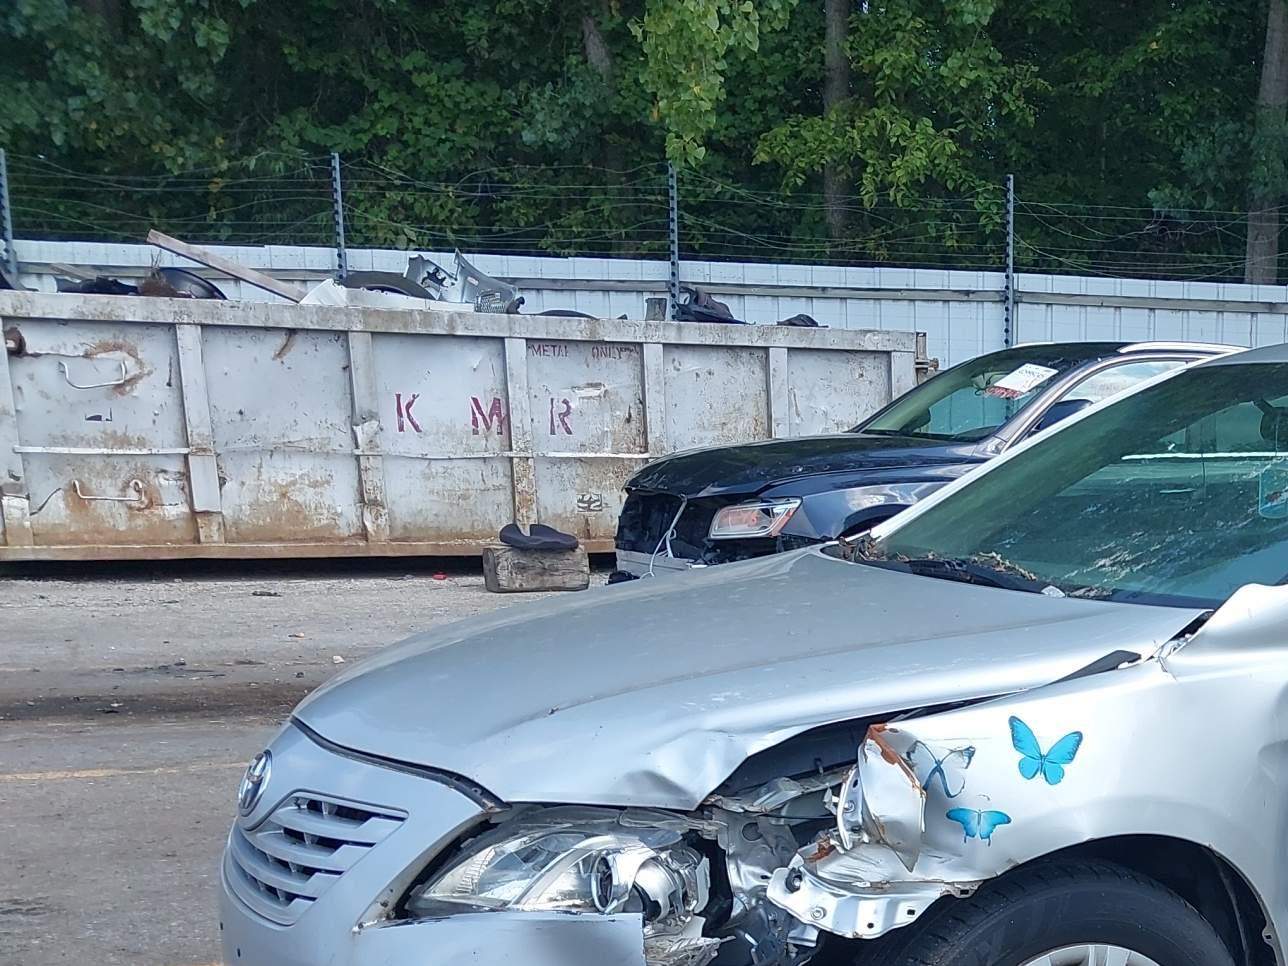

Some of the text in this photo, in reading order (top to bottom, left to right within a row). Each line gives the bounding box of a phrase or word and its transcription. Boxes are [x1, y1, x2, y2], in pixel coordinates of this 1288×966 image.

[394, 392, 574, 435] K M R
